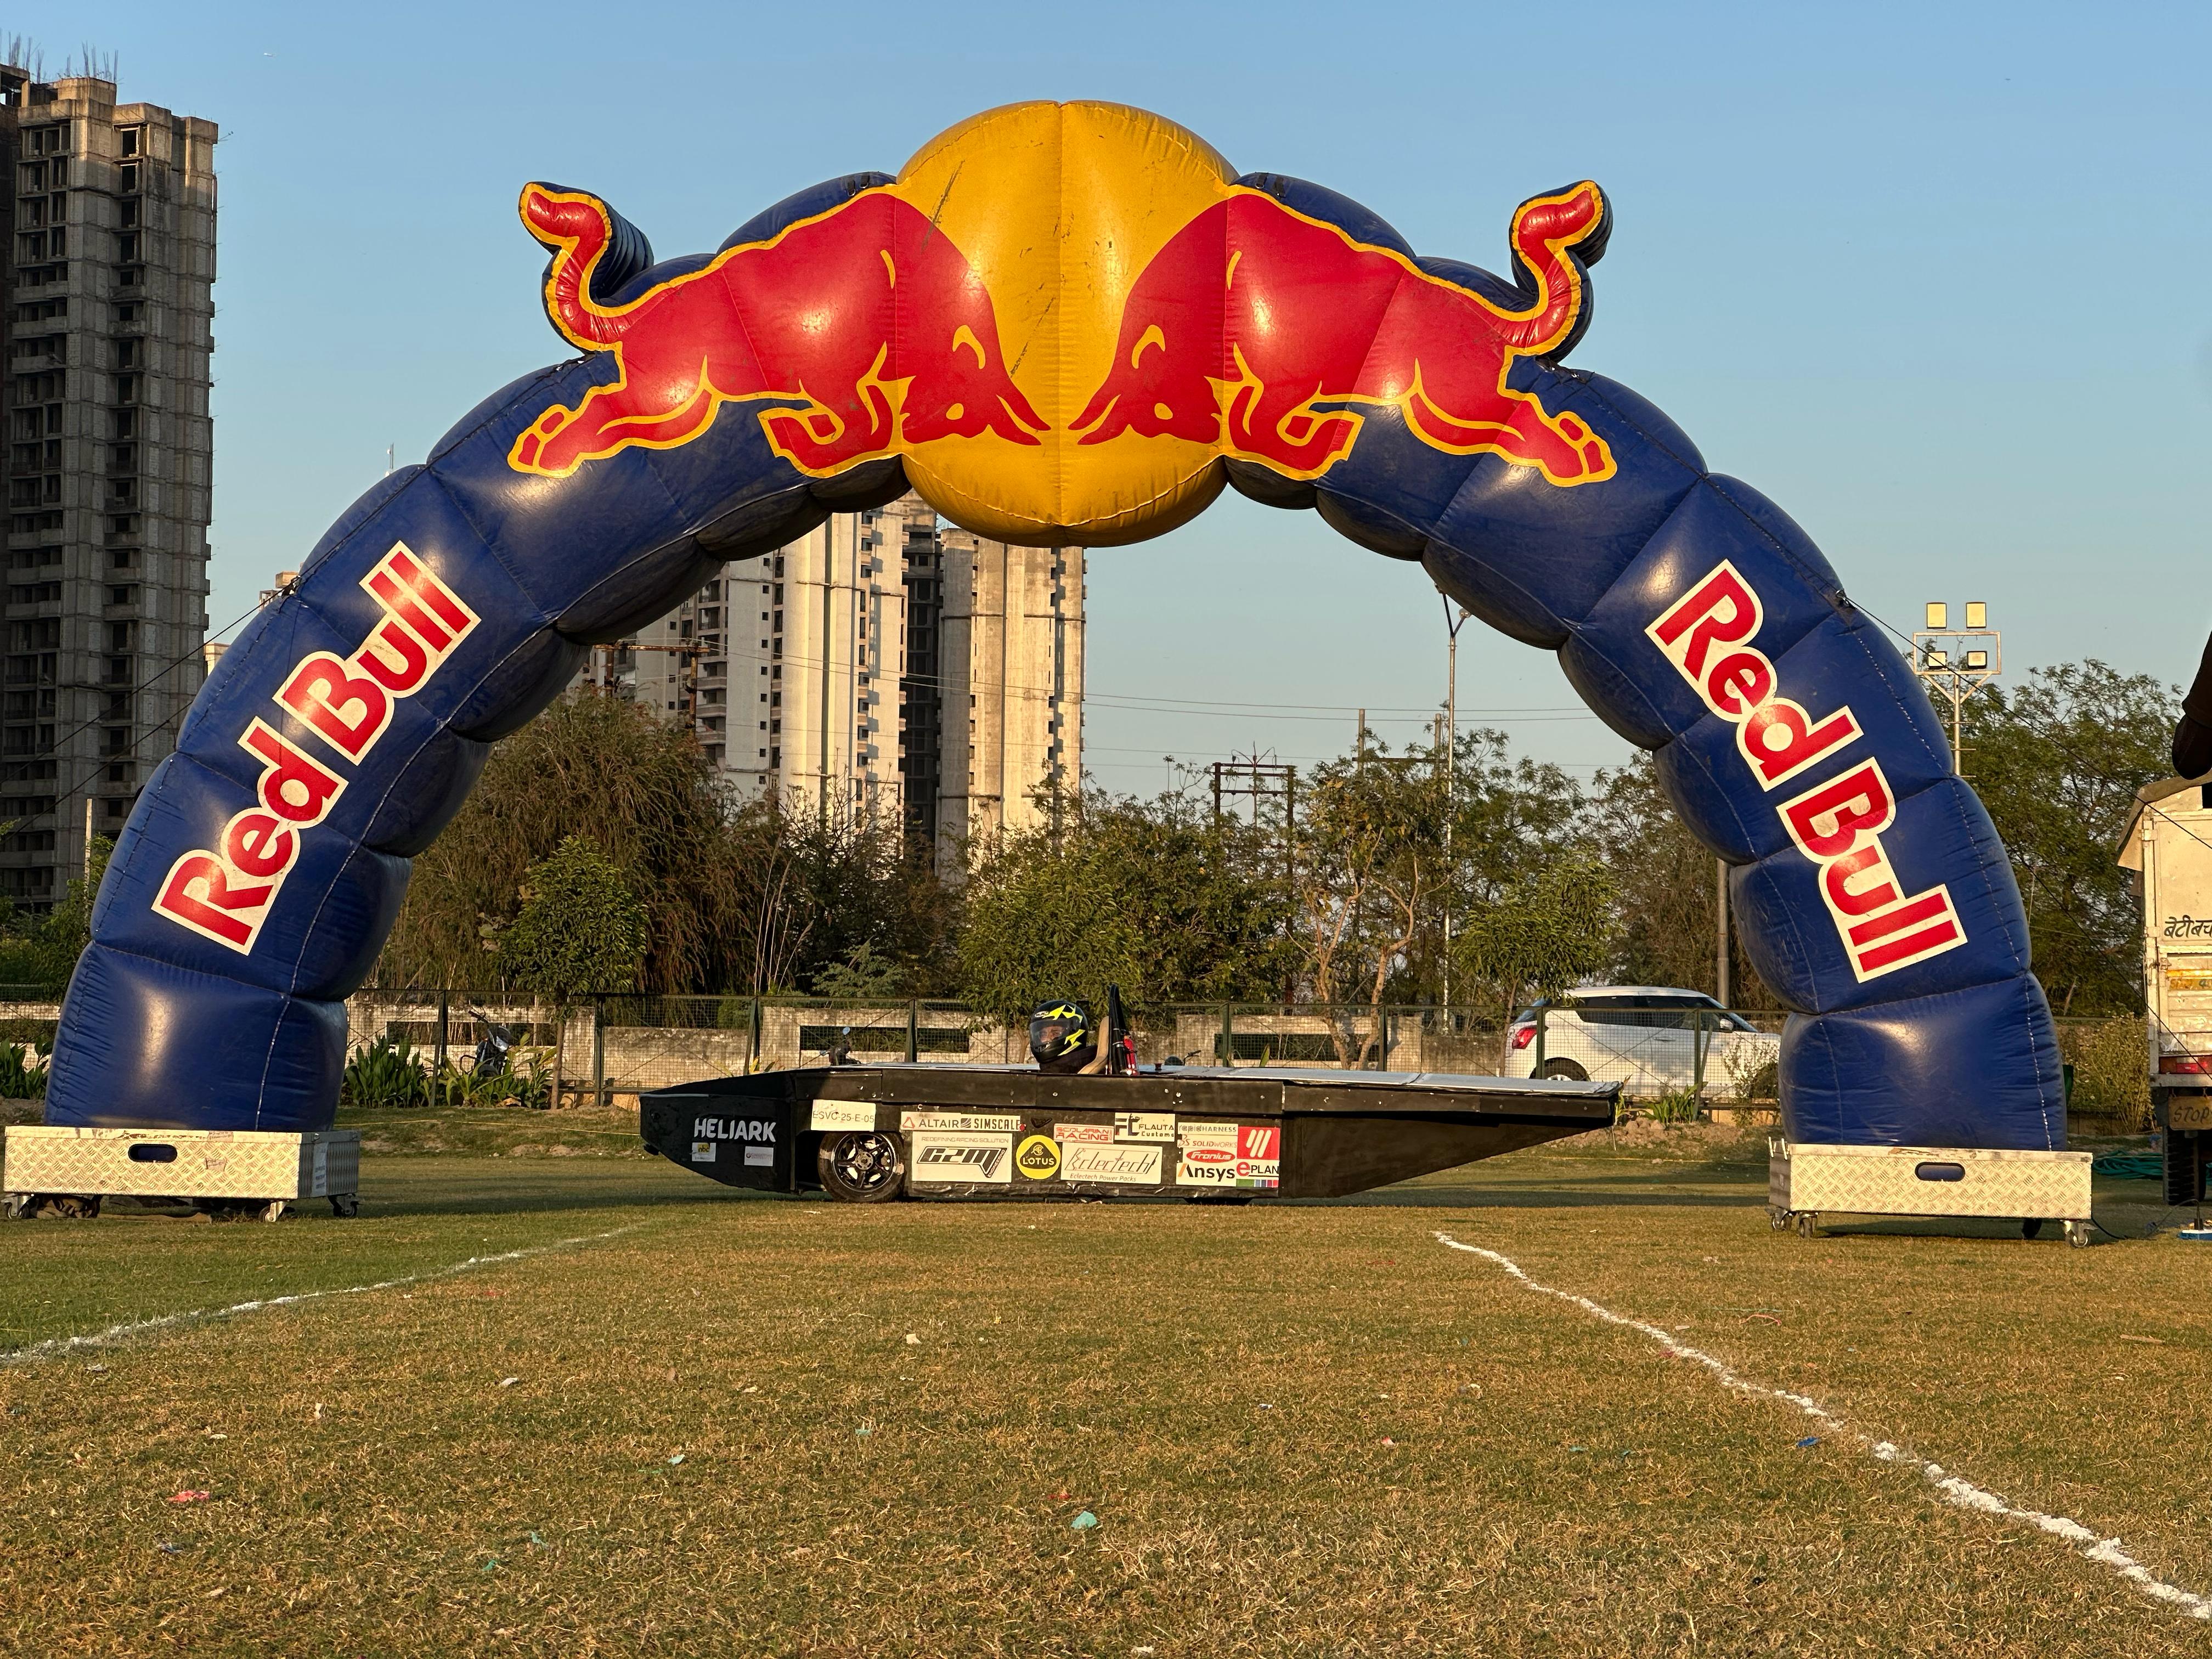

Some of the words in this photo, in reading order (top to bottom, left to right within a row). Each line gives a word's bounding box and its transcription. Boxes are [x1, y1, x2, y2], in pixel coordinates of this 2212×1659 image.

[156, 721, 344, 951] Red
[277, 545, 476, 761] Bull
[1650, 563, 1860, 787] Red
[1781, 761, 1962, 978] Bull
[2164, 915, 2194, 939] बेटी
[812, 1110, 874, 1123] ESVC-25-E-05
[918, 1119, 959, 1128] ALTAIR
[2174, 1105, 2210, 1124] STOP
[693, 1118, 777, 1142] HELIARK
[1056, 1132, 1109, 1141] RACING
[1023, 1157, 1055, 1166] LOTUS
[1190, 1152, 1232, 1160] Fronius
[1178, 1163, 1235, 1182] Ansys
